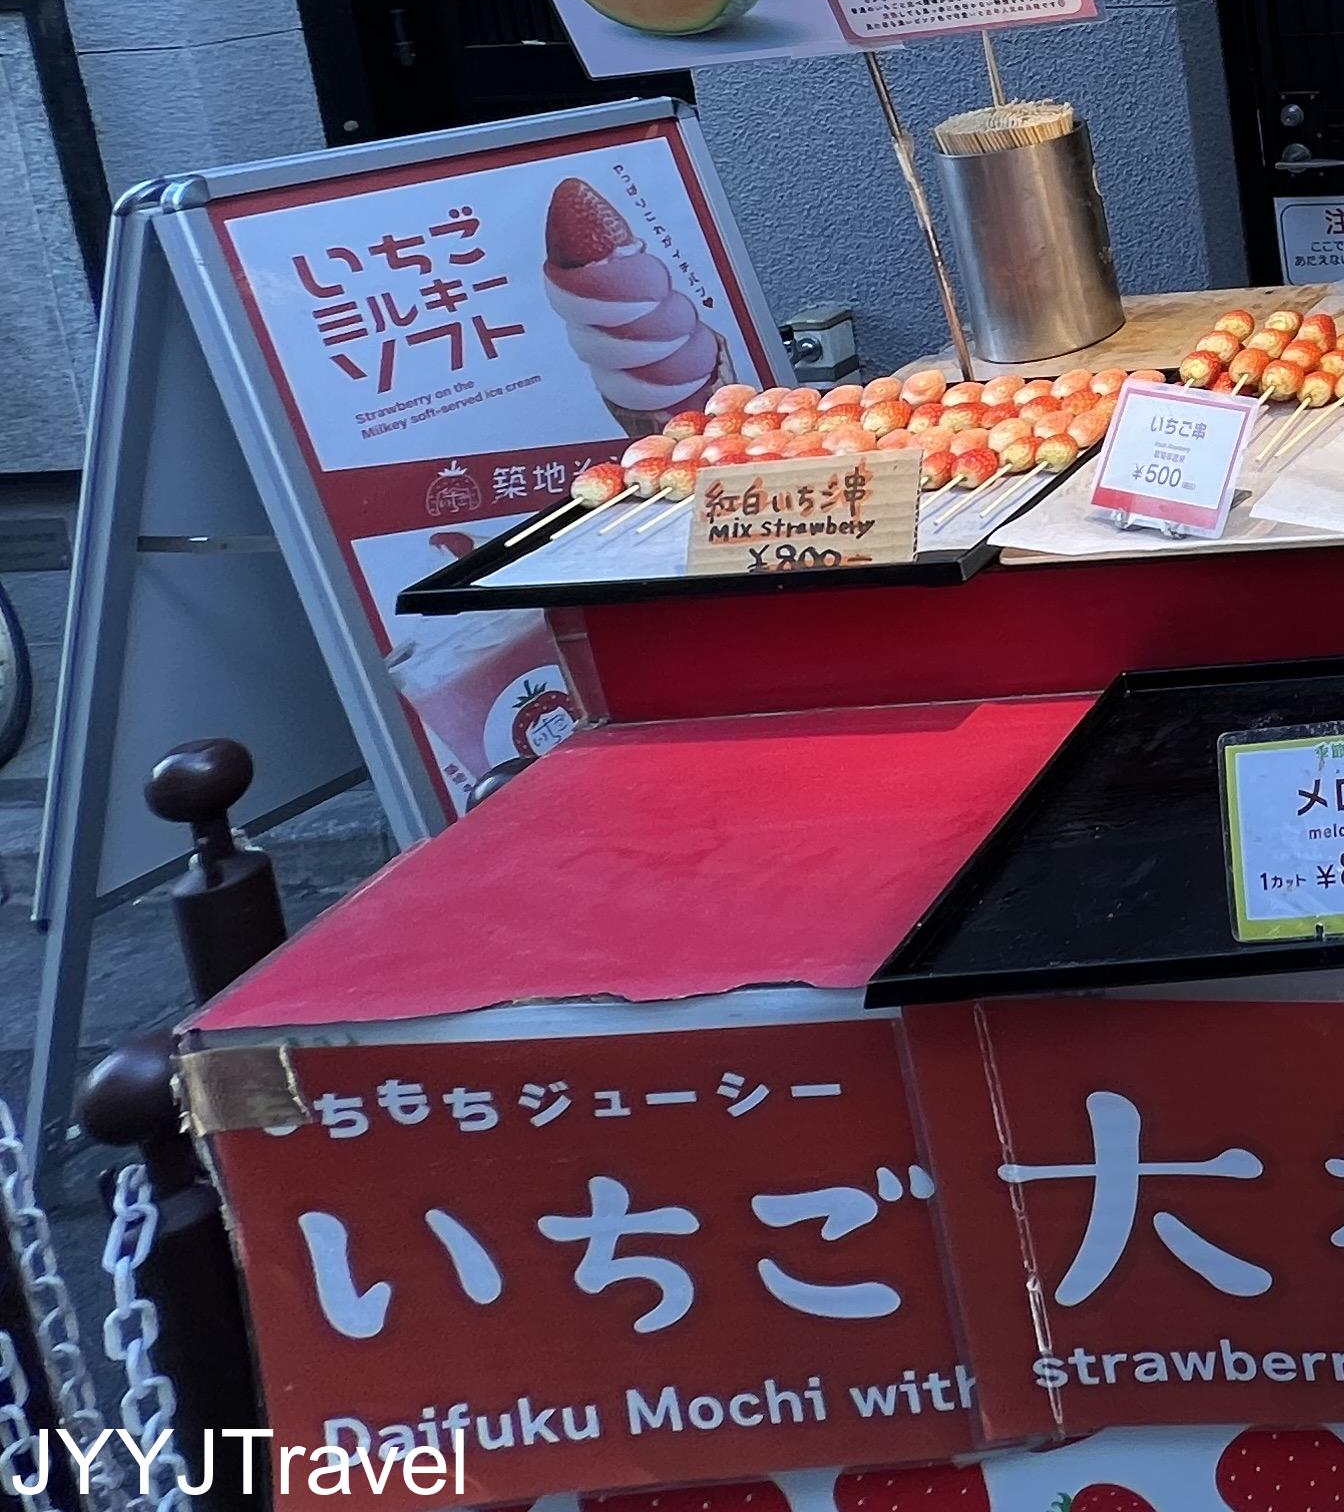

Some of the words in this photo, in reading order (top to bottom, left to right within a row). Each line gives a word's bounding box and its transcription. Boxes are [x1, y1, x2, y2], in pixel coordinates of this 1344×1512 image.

[292, 205, 487, 298] いちご
[314, 276, 508, 348] ミルキー
[330, 315, 524, 394] ソフト
[505, 375, 542, 393] cream
[355, 392, 432, 425] Strawberry
[434, 388, 451, 399] on
[453, 379, 475, 394] the
[1132, 463, 1182, 488] ¥500
[629, 1376, 827, 1436] Mochi
